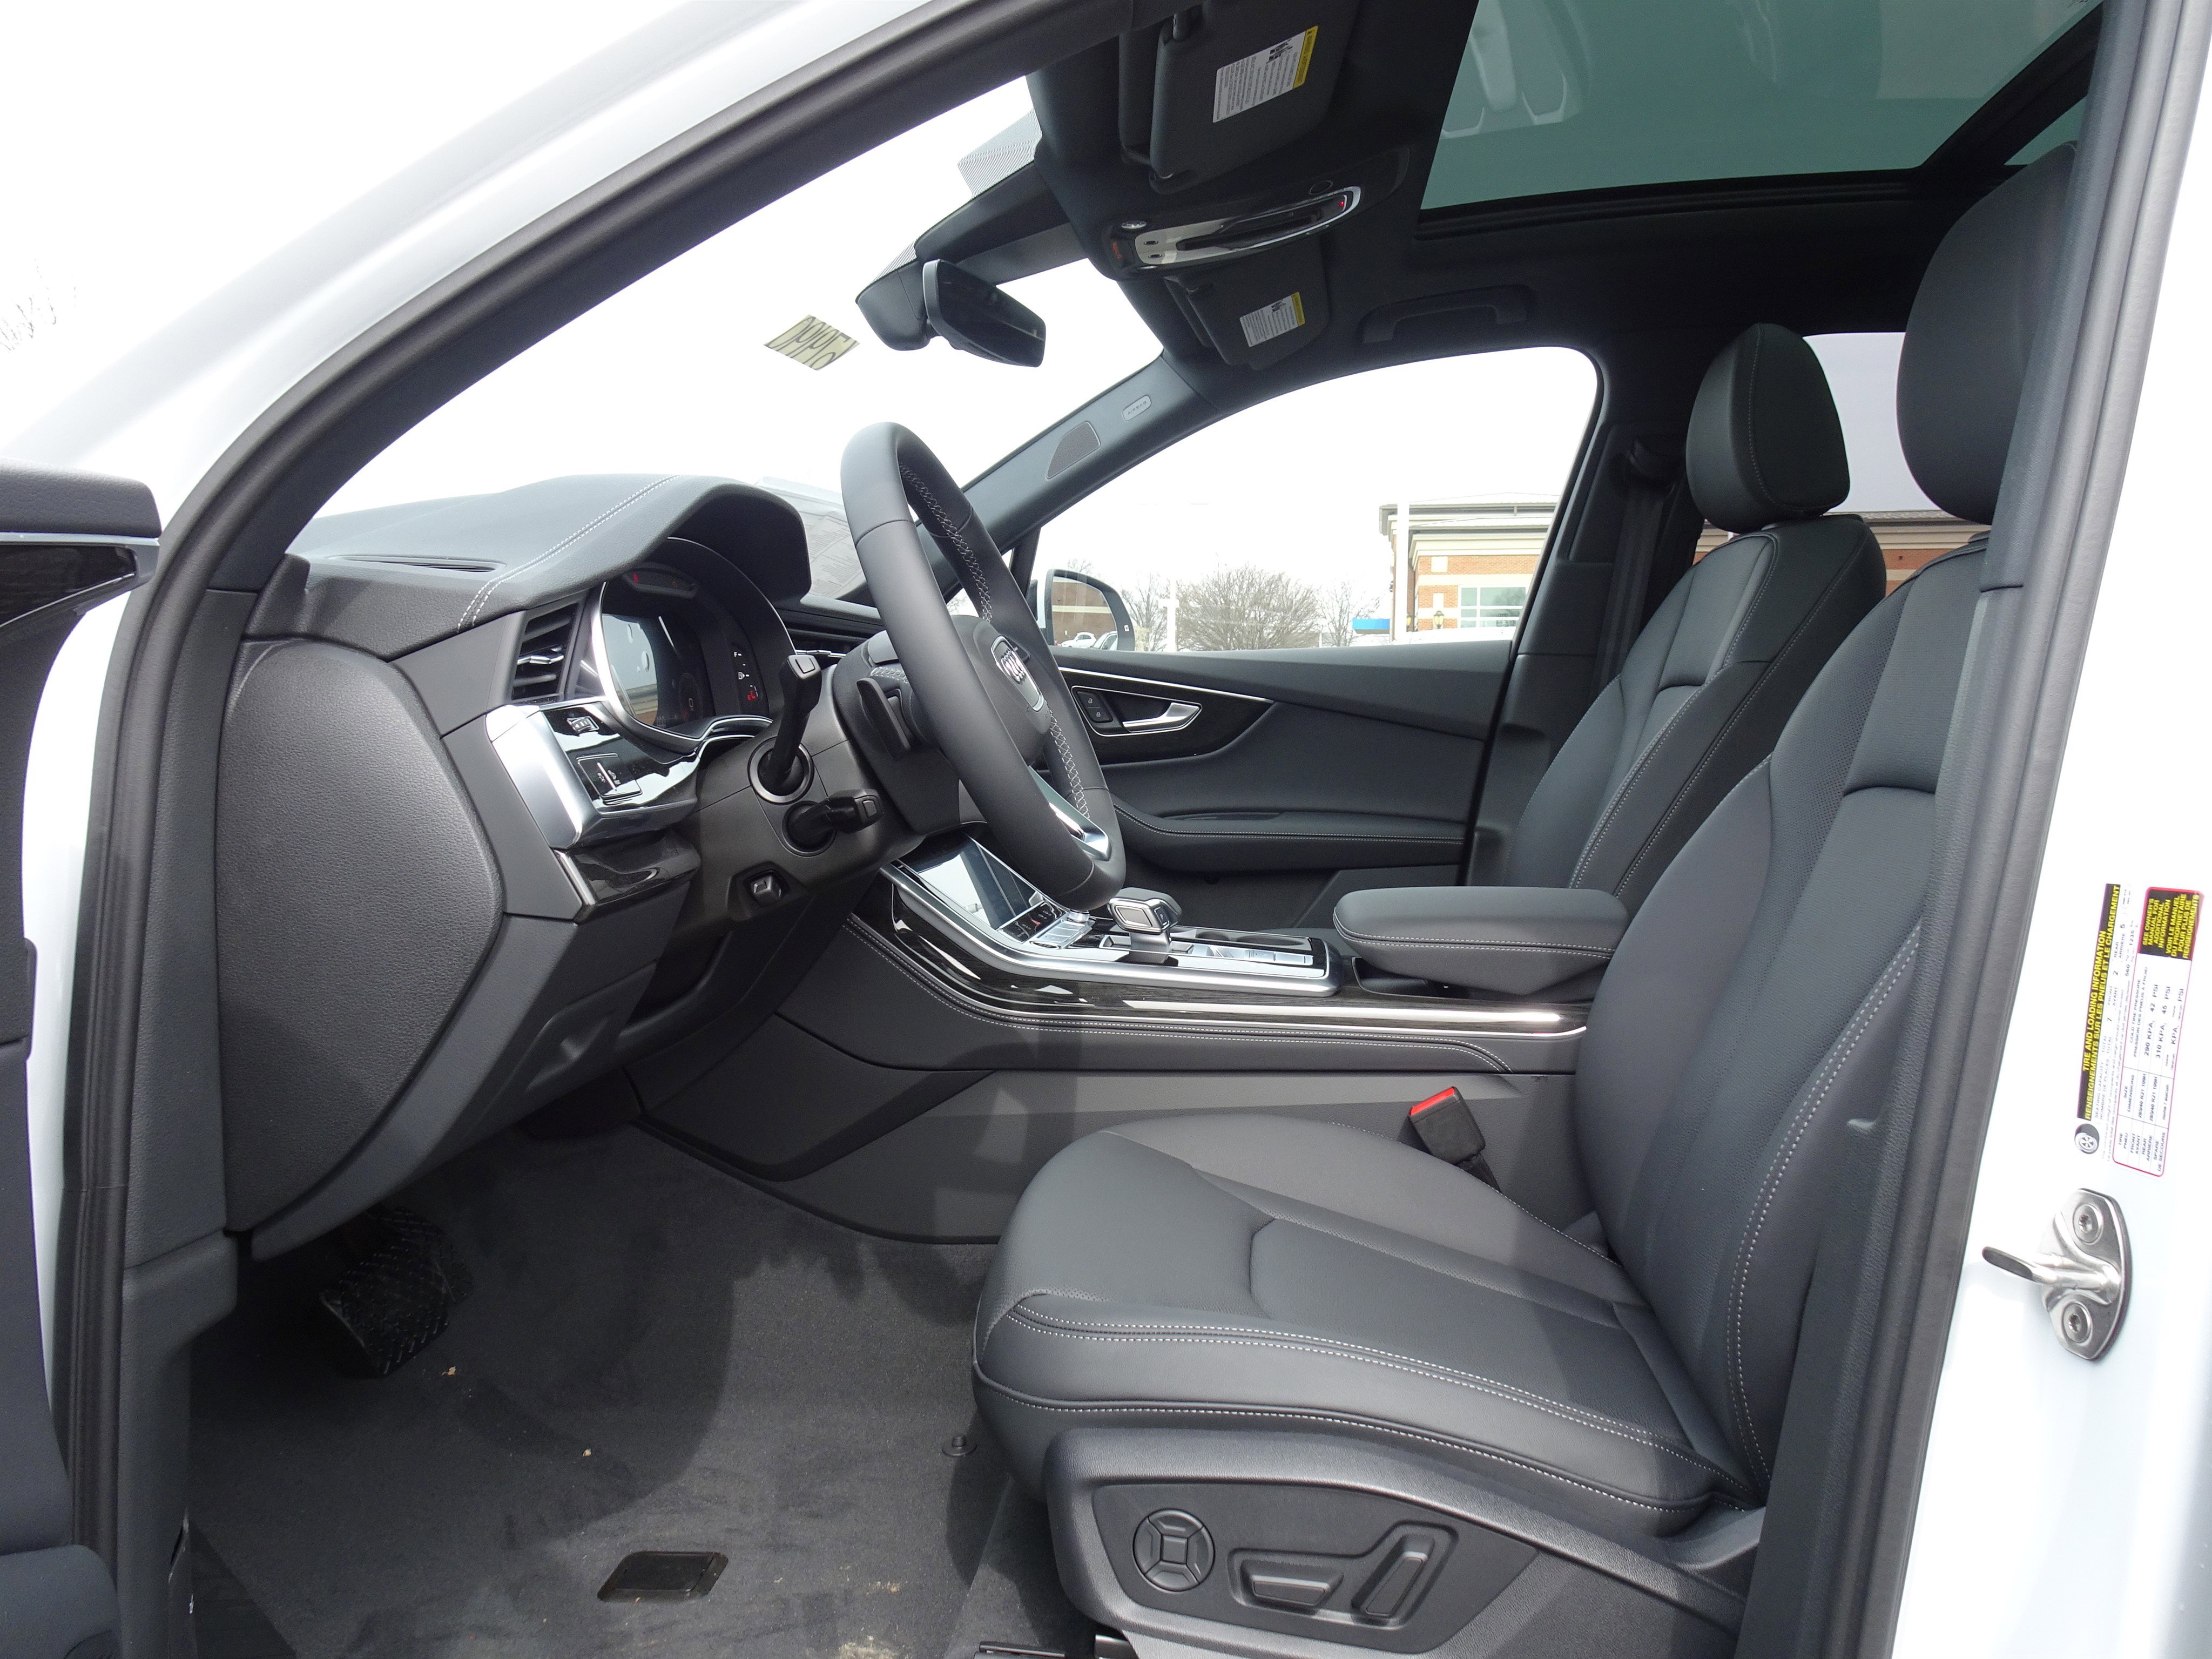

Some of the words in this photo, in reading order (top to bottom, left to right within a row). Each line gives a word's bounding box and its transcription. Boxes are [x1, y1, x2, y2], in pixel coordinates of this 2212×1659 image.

[2105, 885, 2119, 946] CHARGEMENT
[2170, 895, 2180, 925] MANUEL
[2184, 900, 2191, 910] DE
[2147, 915, 2156, 945] MANUAL
[2153, 902, 2164, 944] ADDITIONAL
[2158, 899, 2170, 948] INFORMATION
[2168, 926, 2175, 935] LE
[2181, 911, 2189, 930] PLUS
[2182, 894, 2199, 959] RENSEIGNEMENTS
[2171, 946, 2177, 956] DU
[2177, 930, 2186, 952] POUR
[2092, 930, 2106, 990] INFORMATION
[2103, 947, 2110, 958] LE
[2101, 959, 2109, 970] ET
[2098, 972, 2107, 1001] PNEUS
[2087, 992, 2098, 1030] LOADING
[2149, 1002, 2155, 1012] 42
[2161, 1004, 2167, 1014] 45
[2085, 1032, 2093, 1051] AND
[2082, 1051, 2091, 1071] TIRE
[2084, 1040, 2099, 1120] RENSEIGNEMENTS
